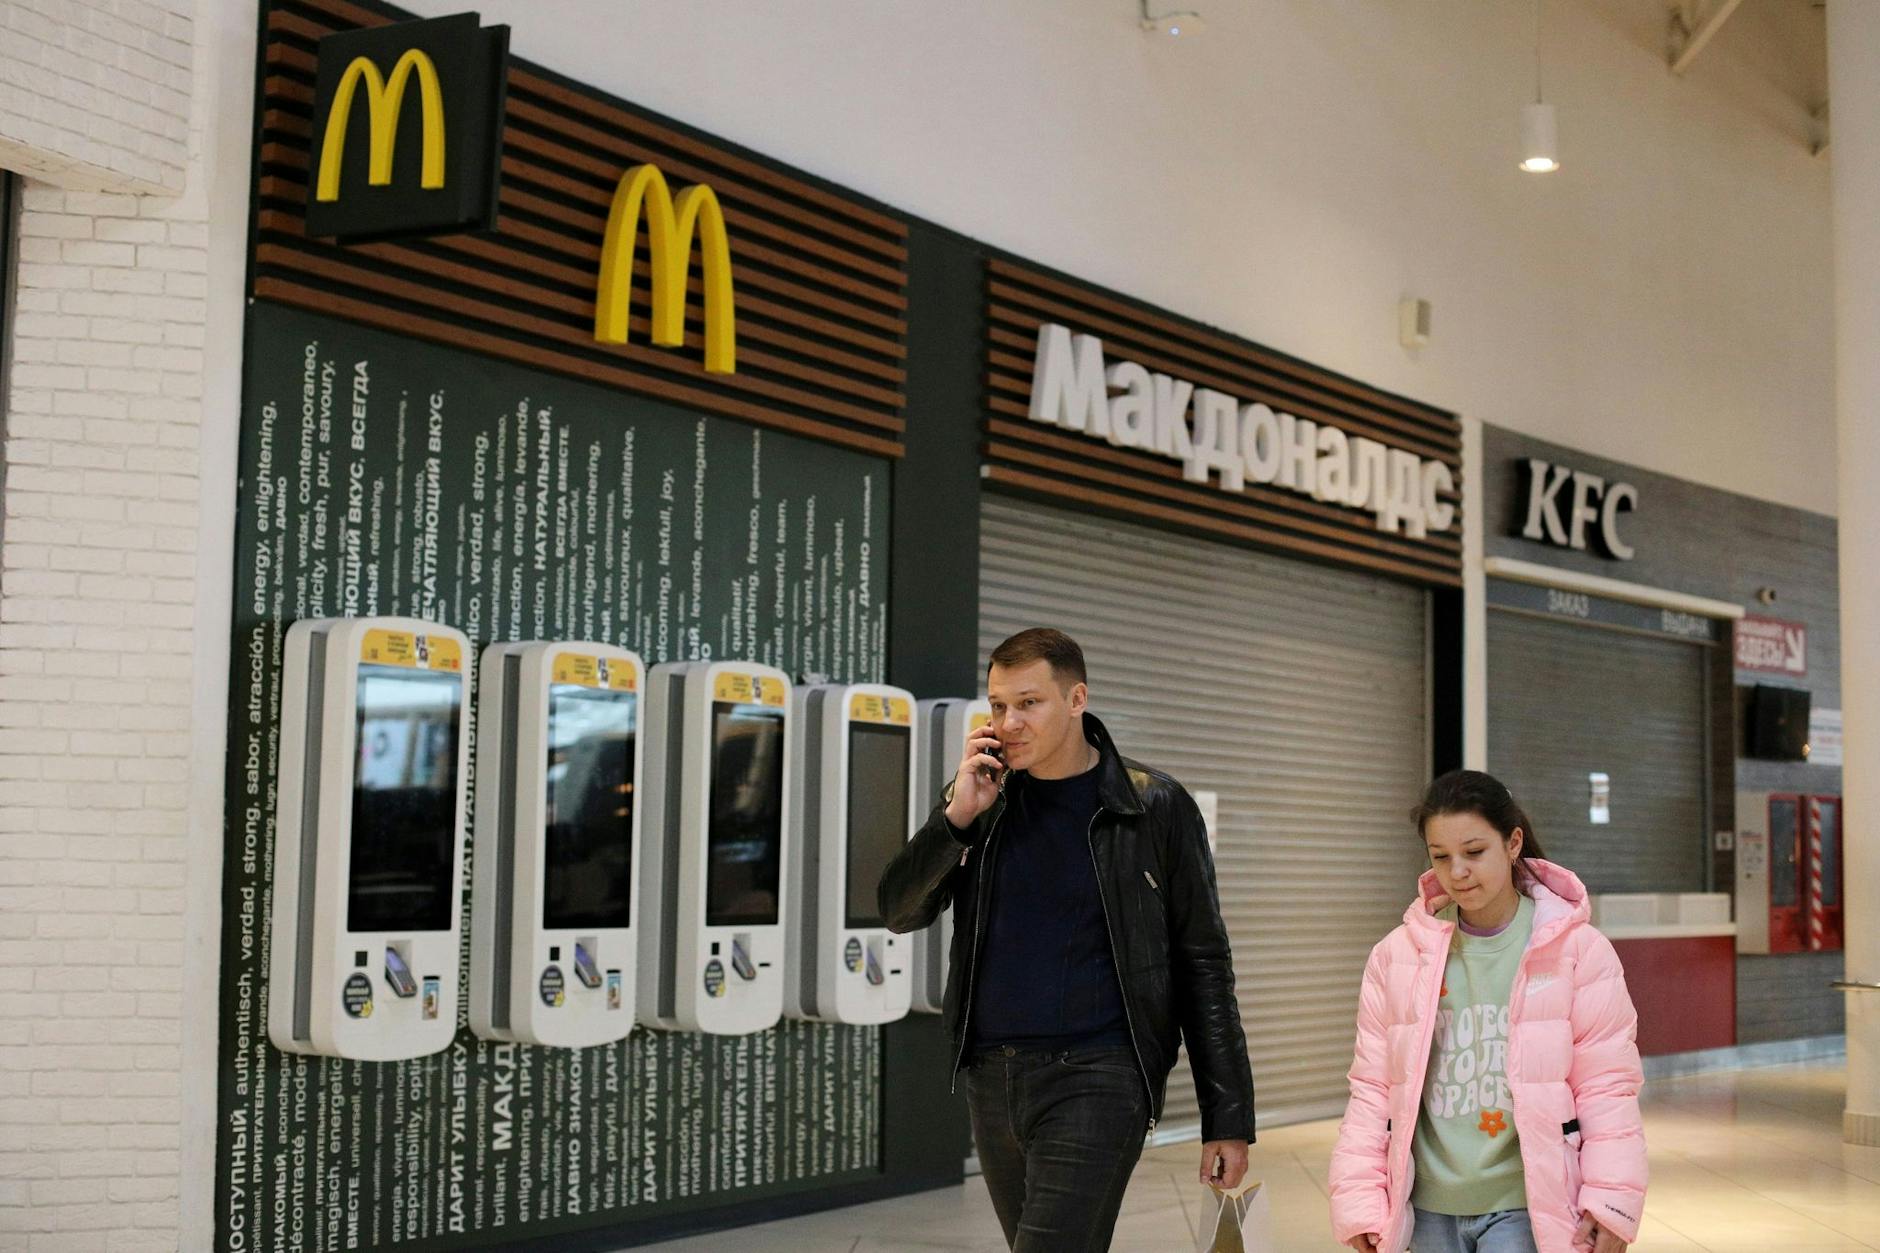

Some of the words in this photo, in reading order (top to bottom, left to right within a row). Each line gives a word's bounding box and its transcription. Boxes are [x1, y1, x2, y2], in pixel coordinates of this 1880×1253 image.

[298, 340, 317, 503] contemporaneo,
[318, 360, 336, 442] savoury,
[350, 360, 369, 450] ВСЕГДА
[428, 389, 444, 452] ВКУС,
[514, 396, 529, 474] levande,
[1028, 323, 1457, 540] Макдоналдс
[255, 401, 277, 531] enlightening,
[316, 449, 331, 487] pur,
[347, 457, 365, 523] ВКУС,
[472, 430, 490, 500] strong,
[585, 440, 601, 534] mothering,
[621, 426, 634, 519] qualitative,
[660, 468, 675, 501] joy,
[693, 420, 707, 540] aconchegante,
[297, 510, 310, 567] verdad,
[311, 493, 329, 550] fresh,
[369, 476, 384, 555] refreshing,
[421, 457, 441, 621] ЕЧАТЛЯЮЩИЙ
[469, 507, 485, 584] verdad,
[555, 495, 568, 558] ВСЕГДА
[658, 505, 672, 565] lekfull,
[746, 503, 760, 564] fresco,
[1523, 459, 1638, 560] KFC
[253, 538, 271, 614] energy,
[310, 557, 328, 619] plicity,
[343, 528, 362, 619] ЯЮЩИЙ
[366, 560, 379, 617] ЬНЫЙ,
[508, 562, 523, 642] ttraction,
[619, 525, 631, 621] savoureux,
[690, 546, 703, 617] levande,
[859, 541, 870, 607] ДАВНО
[656, 571, 672, 663] elcoming,
[248, 622, 266, 723] atracción,
[245, 730, 262, 794] sabor,
[242, 801, 261, 873] strong,
[252, 1043, 266, 1182] ПРИТЯГАТЕЛЬНЫЙ,
[275, 475, 287, 529] ДАВНО
[517, 1102, 534, 1222] enlightening,
[534, 406, 551, 570] НАТУРАЛЬНЫЙ,
[239, 880, 256, 959] verdad,
[393, 1127, 404, 1177] vivant,
[409, 588, 421, 619] rue,
[234, 967, 253, 1095] authentisch,
[824, 1022, 835, 1064] УЛЫ
[1435, 1003, 1509, 1052] PROTEC
[293, 1050, 310, 1122] moder
[451, 1036, 467, 1143] УЛЫБКУ,
[492, 1040, 517, 1150] МАКД
[569, 1046, 583, 1132] ЗНАКОМ
[1430, 1074, 1514, 1119] SPACE
[350, 1090, 362, 1167] universell,
[643, 1127, 657, 1202] ДАРИТ
[229, 1102, 248, 1253] ОСТУПНЫЙ,
[289, 1128, 306, 1253] décontracté,
[326, 1159, 343, 1251] magisch,
[346, 1172, 360, 1248] ВМЕСТЕ,
[406, 1106, 423, 1239] responsibility,
[449, 1150, 465, 1232] ДАРИТ
[492, 1156, 507, 1226] brillant,
[567, 1138, 581, 1214] ДАВНО
